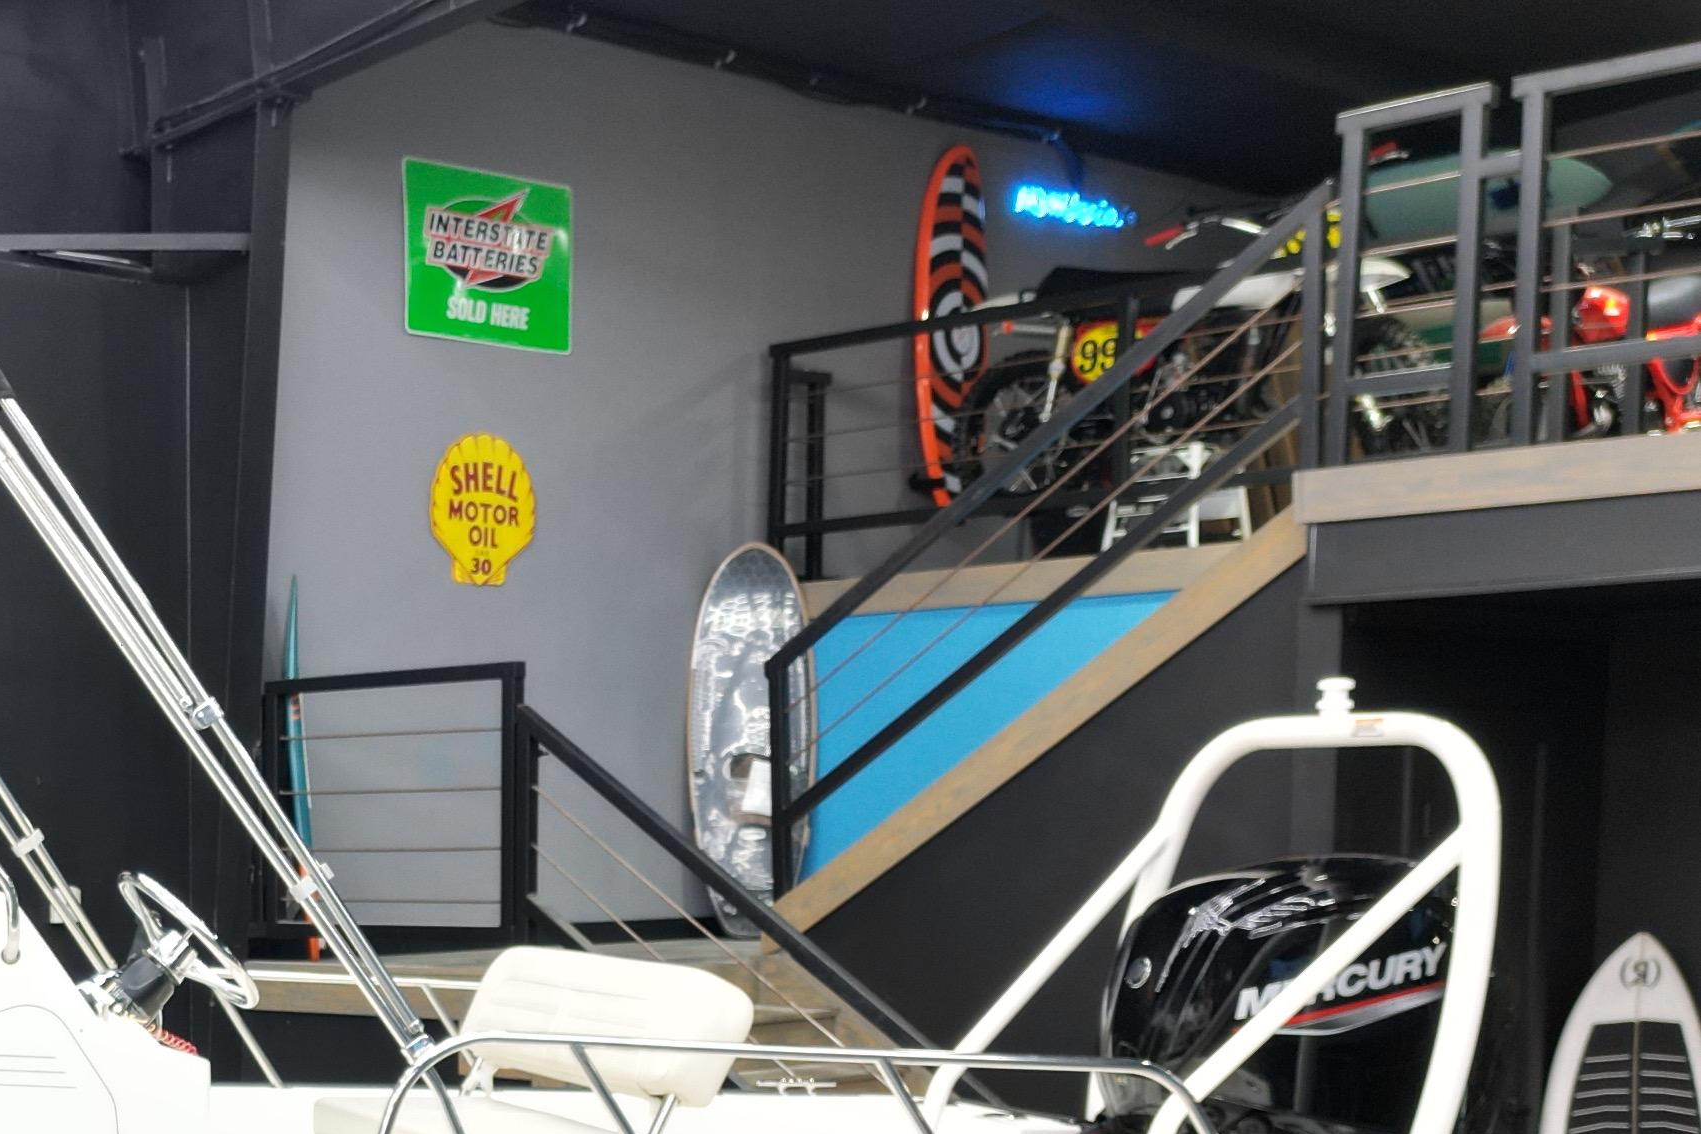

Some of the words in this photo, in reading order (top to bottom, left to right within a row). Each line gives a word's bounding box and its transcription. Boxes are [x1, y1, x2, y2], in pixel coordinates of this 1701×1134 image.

[429, 213, 548, 250] INTERSTATE
[432, 241, 539, 275] BATTERIES
[446, 296, 488, 324] SOLD
[490, 302, 531, 331] HERE
[450, 462, 518, 502] SHELL
[449, 499, 519, 527] MOTOR
[468, 525, 498, 548] OIL
[471, 558, 492, 575] 30
